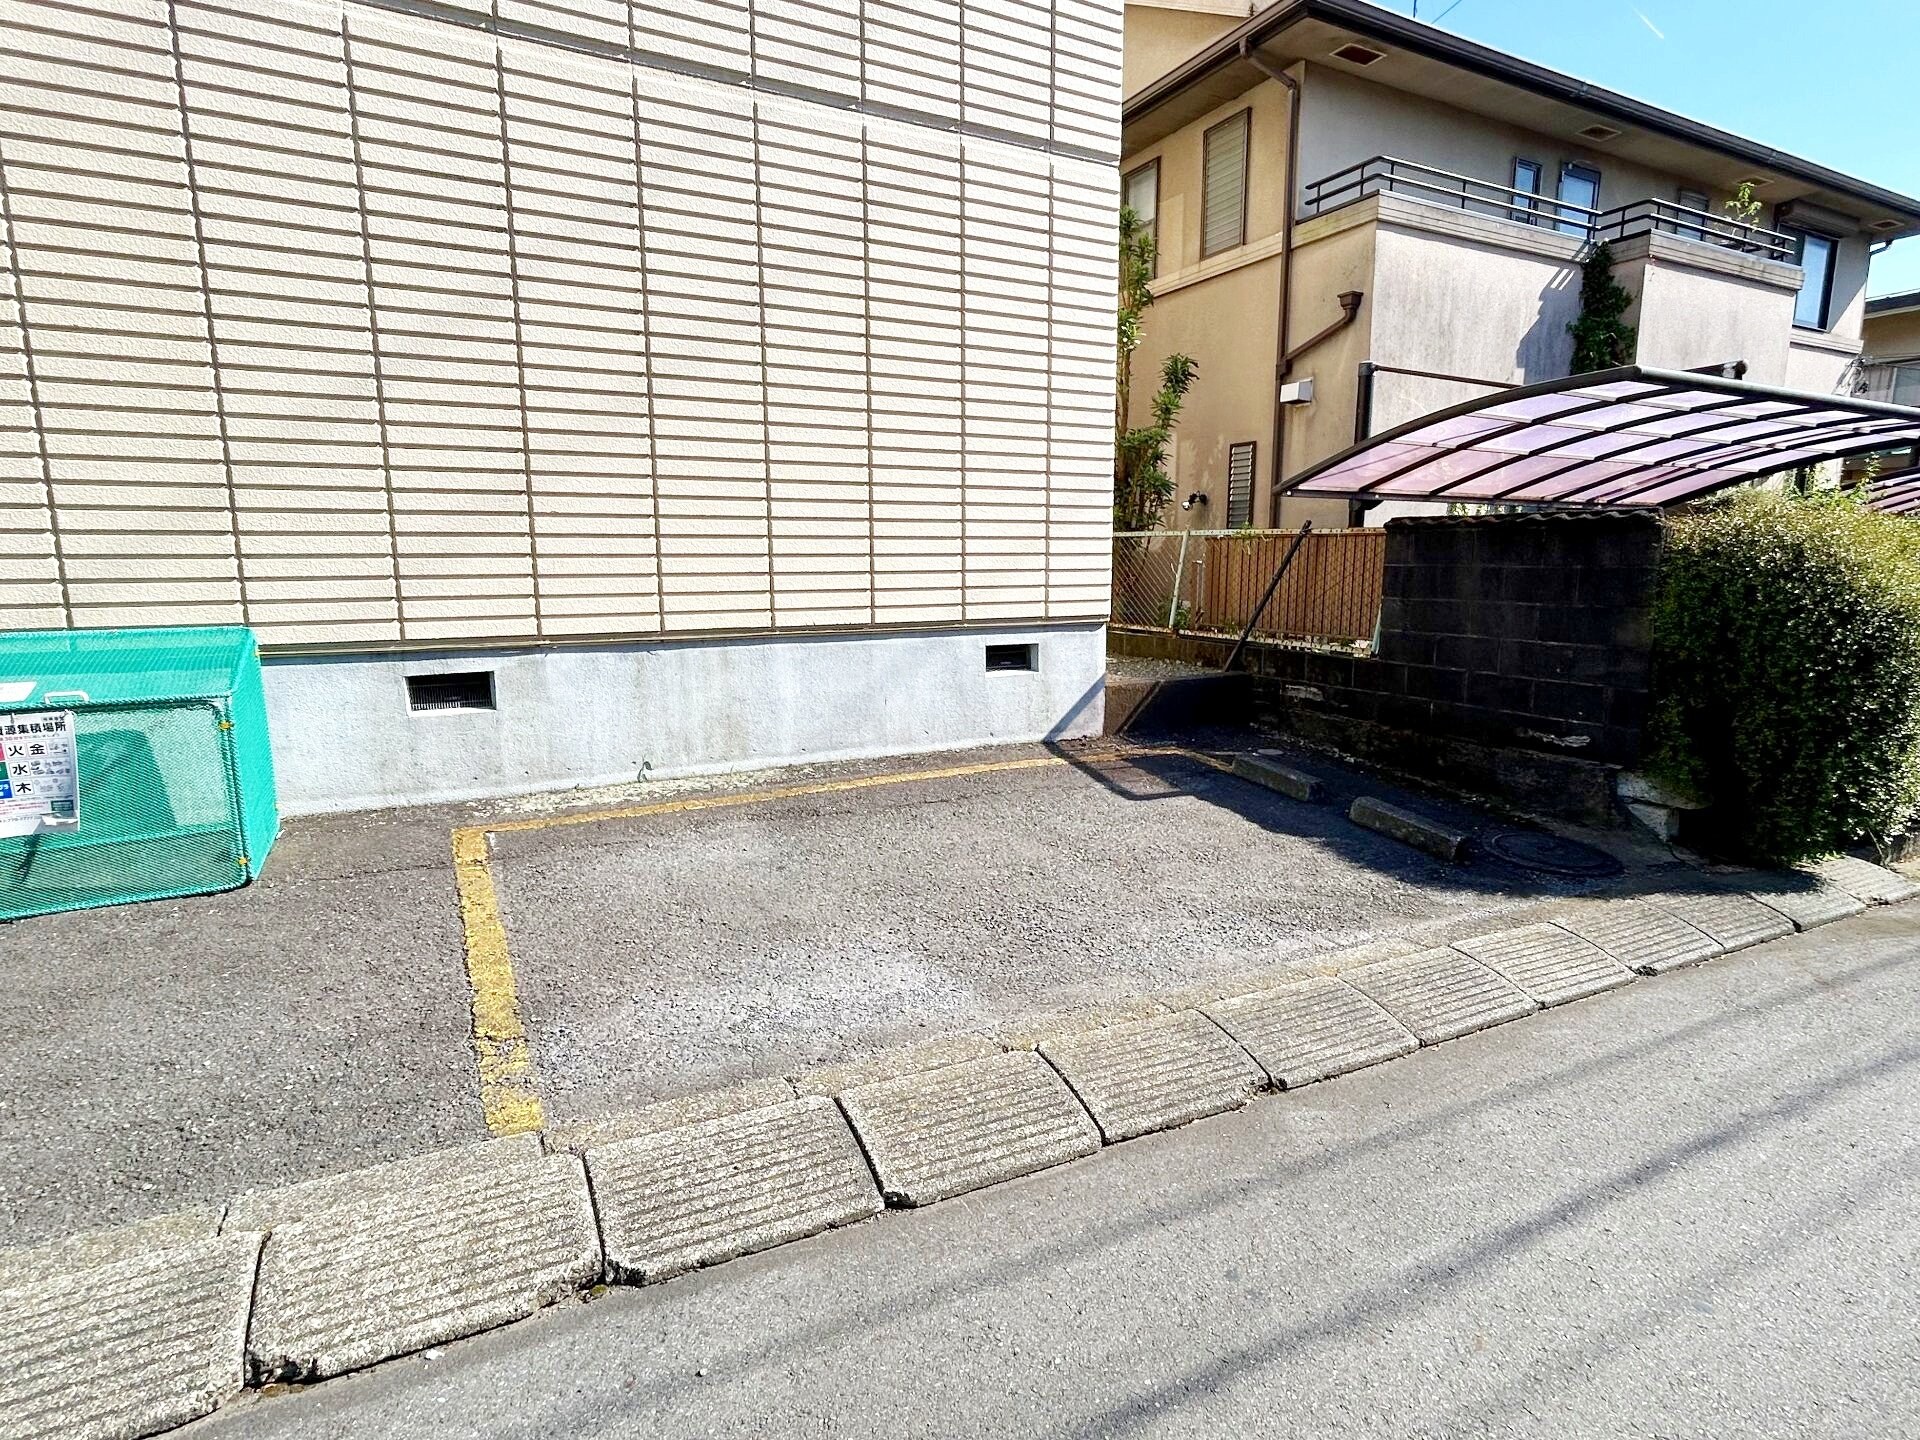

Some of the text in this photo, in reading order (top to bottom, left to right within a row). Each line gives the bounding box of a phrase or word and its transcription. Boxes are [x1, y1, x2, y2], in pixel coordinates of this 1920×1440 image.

[0, 721, 66, 736] 源集積場所
[8, 743, 46, 757] 火 金
[12, 764, 28, 775] 水
[15, 782, 32, 794] 木
